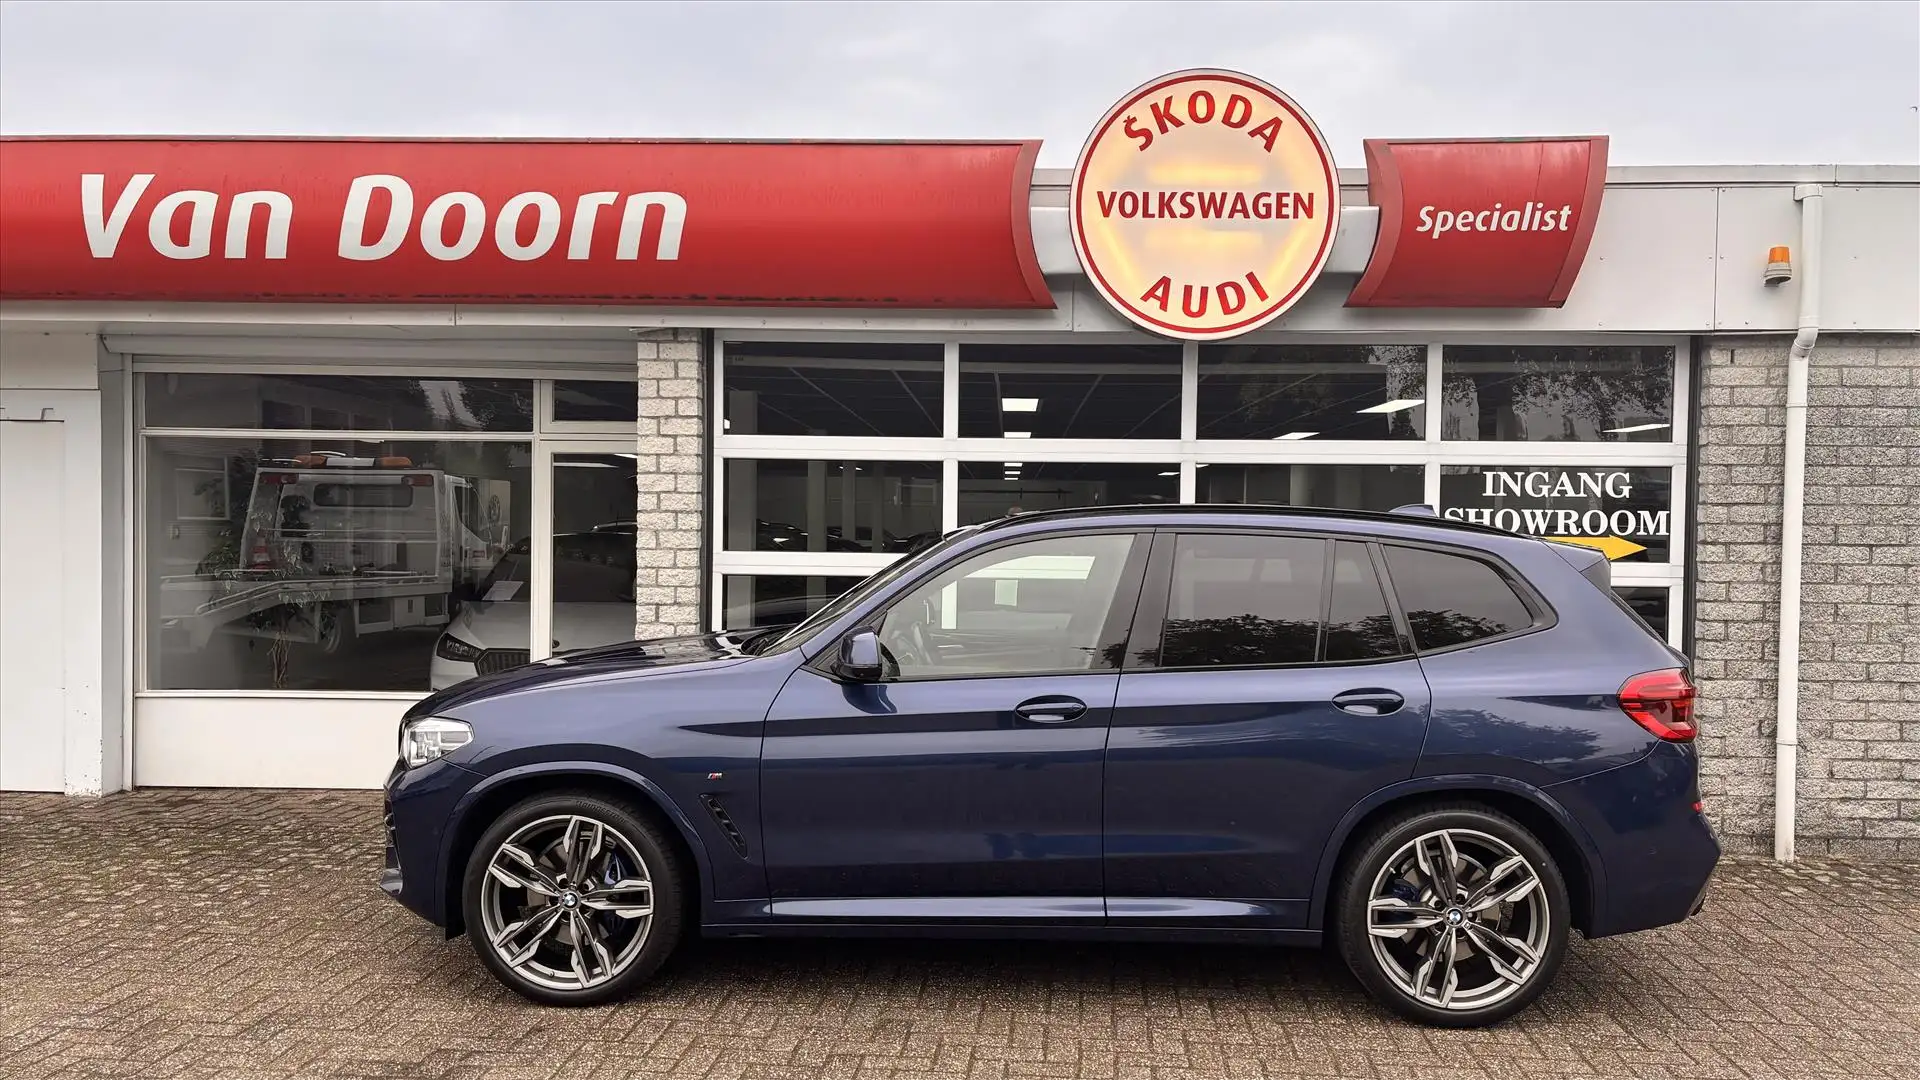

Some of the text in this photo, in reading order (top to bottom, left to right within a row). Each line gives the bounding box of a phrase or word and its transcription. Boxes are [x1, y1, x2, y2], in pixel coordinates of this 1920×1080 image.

[1124, 90, 1283, 152] ŠKODA
[82, 174, 688, 261] Van Doorn
[1097, 191, 1314, 220] VOLKSWAGEN
[1416, 202, 1572, 239] Specialist
[1140, 271, 1270, 320] AUDI
[1482, 471, 1633, 498] INGANG
